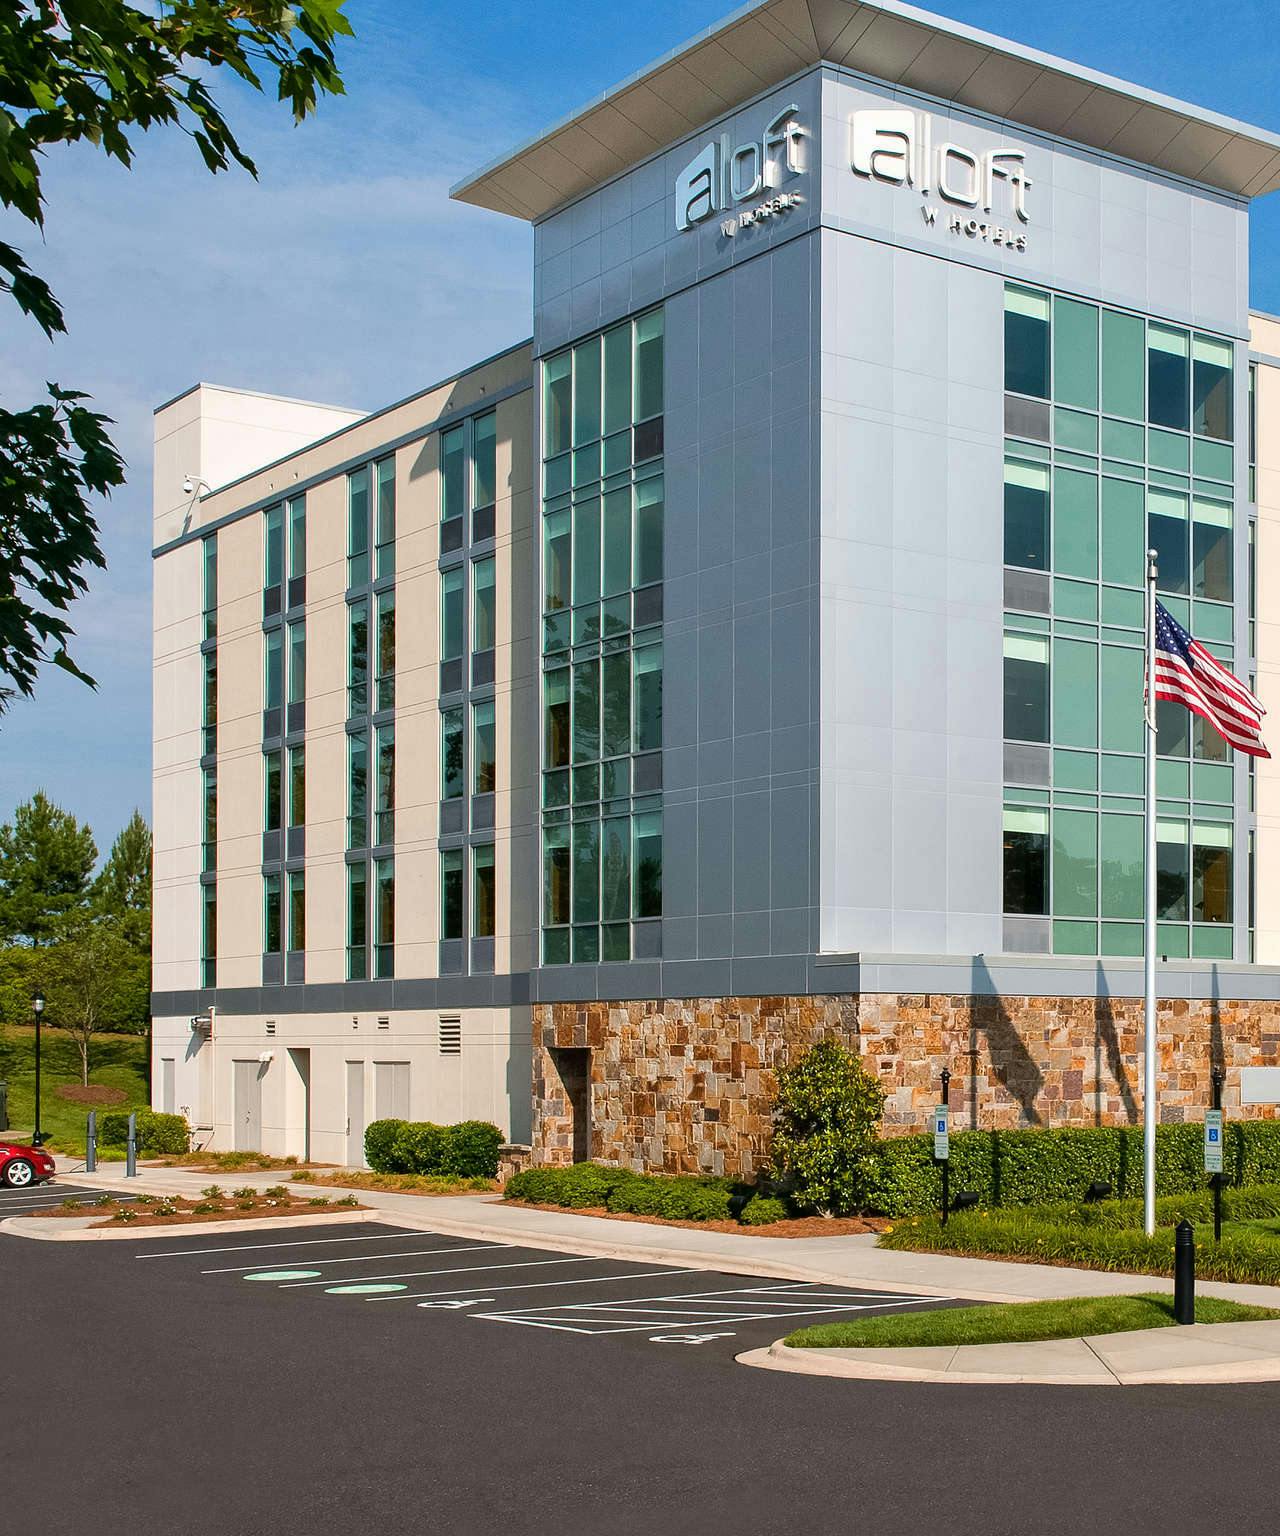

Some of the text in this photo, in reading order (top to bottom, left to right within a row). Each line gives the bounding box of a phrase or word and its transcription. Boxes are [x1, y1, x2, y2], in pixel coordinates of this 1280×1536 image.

[675, 103, 808, 232] aloft
[851, 109, 1033, 225] aloft
[920, 204, 1029, 253] W HOTELS
